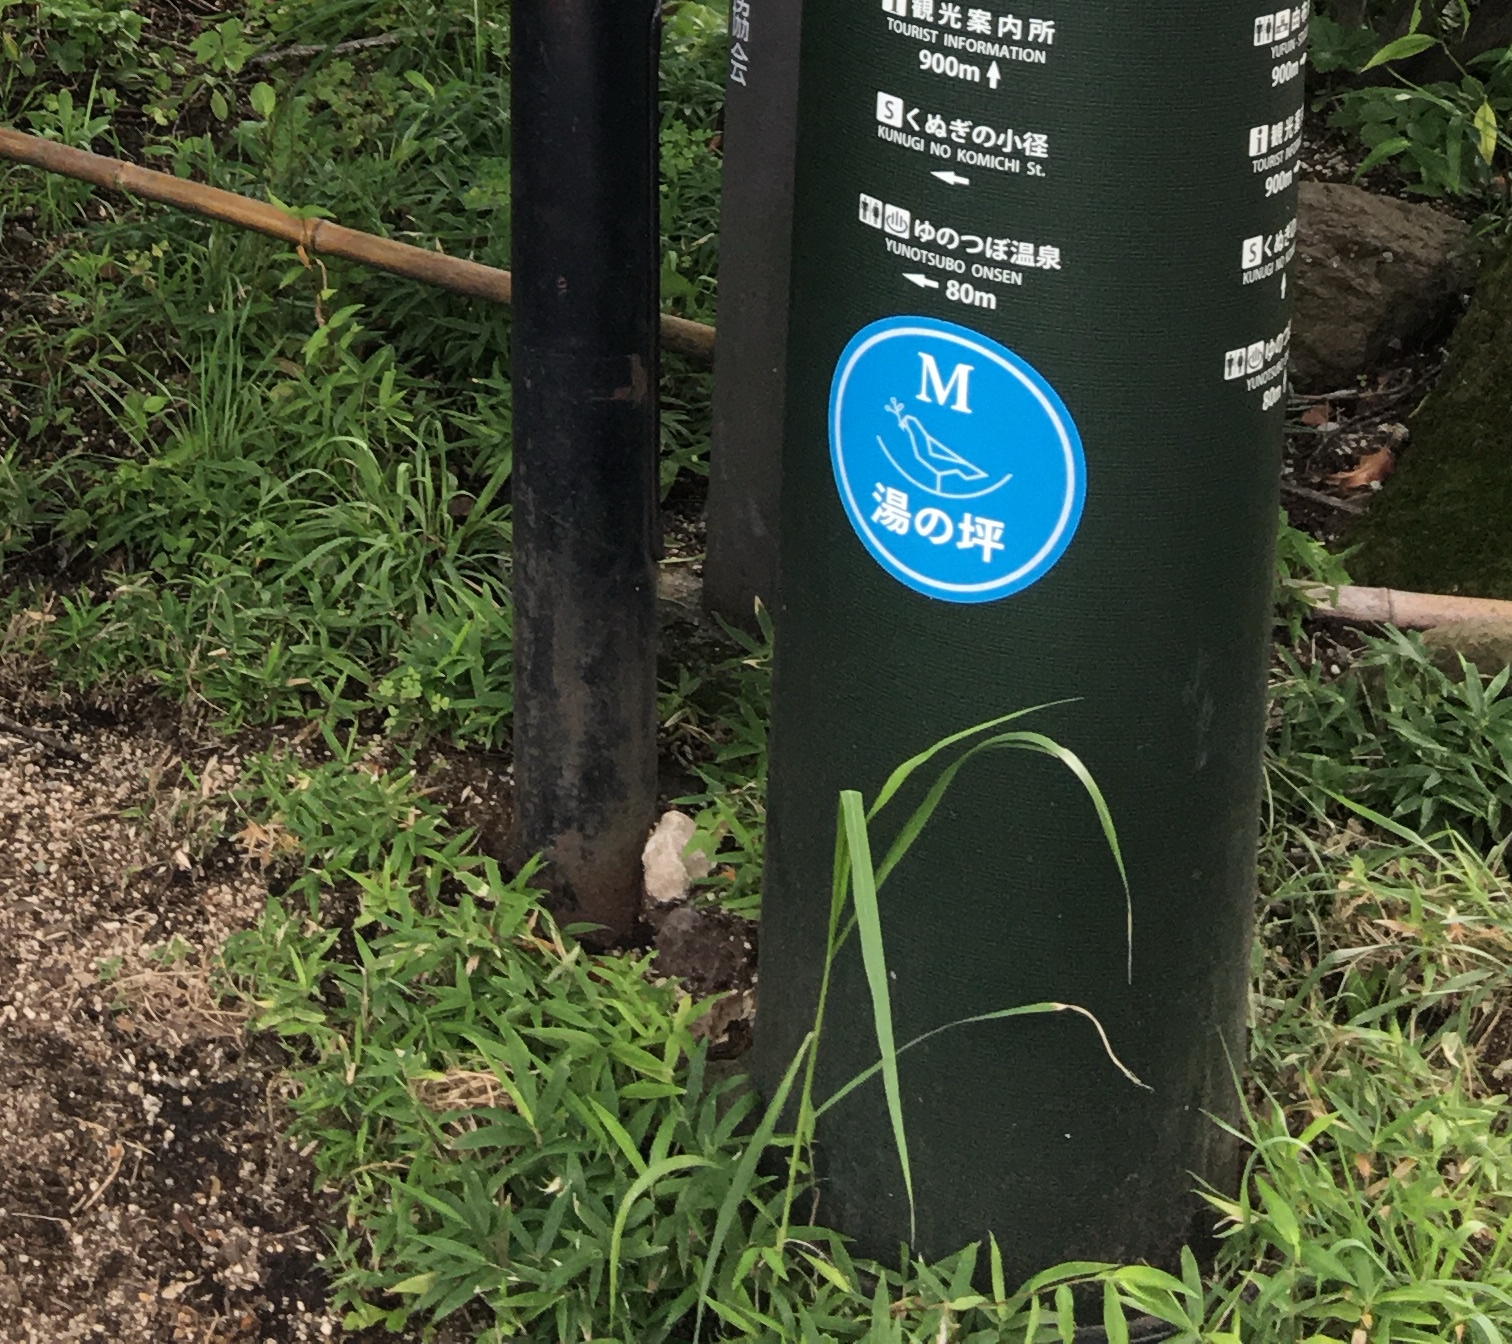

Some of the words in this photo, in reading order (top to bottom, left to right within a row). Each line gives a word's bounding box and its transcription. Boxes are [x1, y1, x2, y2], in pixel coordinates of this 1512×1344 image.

[886, 16, 939, 44] TOURIST
[943, 32, 1047, 65] INFORMATION
[918, 48, 981, 83] 900m
[877, 124, 925, 153] KUNUGI
[929, 140, 952, 159] NO
[956, 147, 1021, 174] KOMICHI
[1026, 161, 1046, 178] St.
[905, 107, 1050, 159] くぬぎの小径
[884, 236, 966, 275] YUNOTSUBO
[971, 263, 1023, 286] ONSEN
[913, 218, 1062, 271] ゆのつぼ温泉
[945, 278, 997, 310] 80m
[915, 351, 975, 414] M
[870, 481, 1006, 563] 湯の坪
